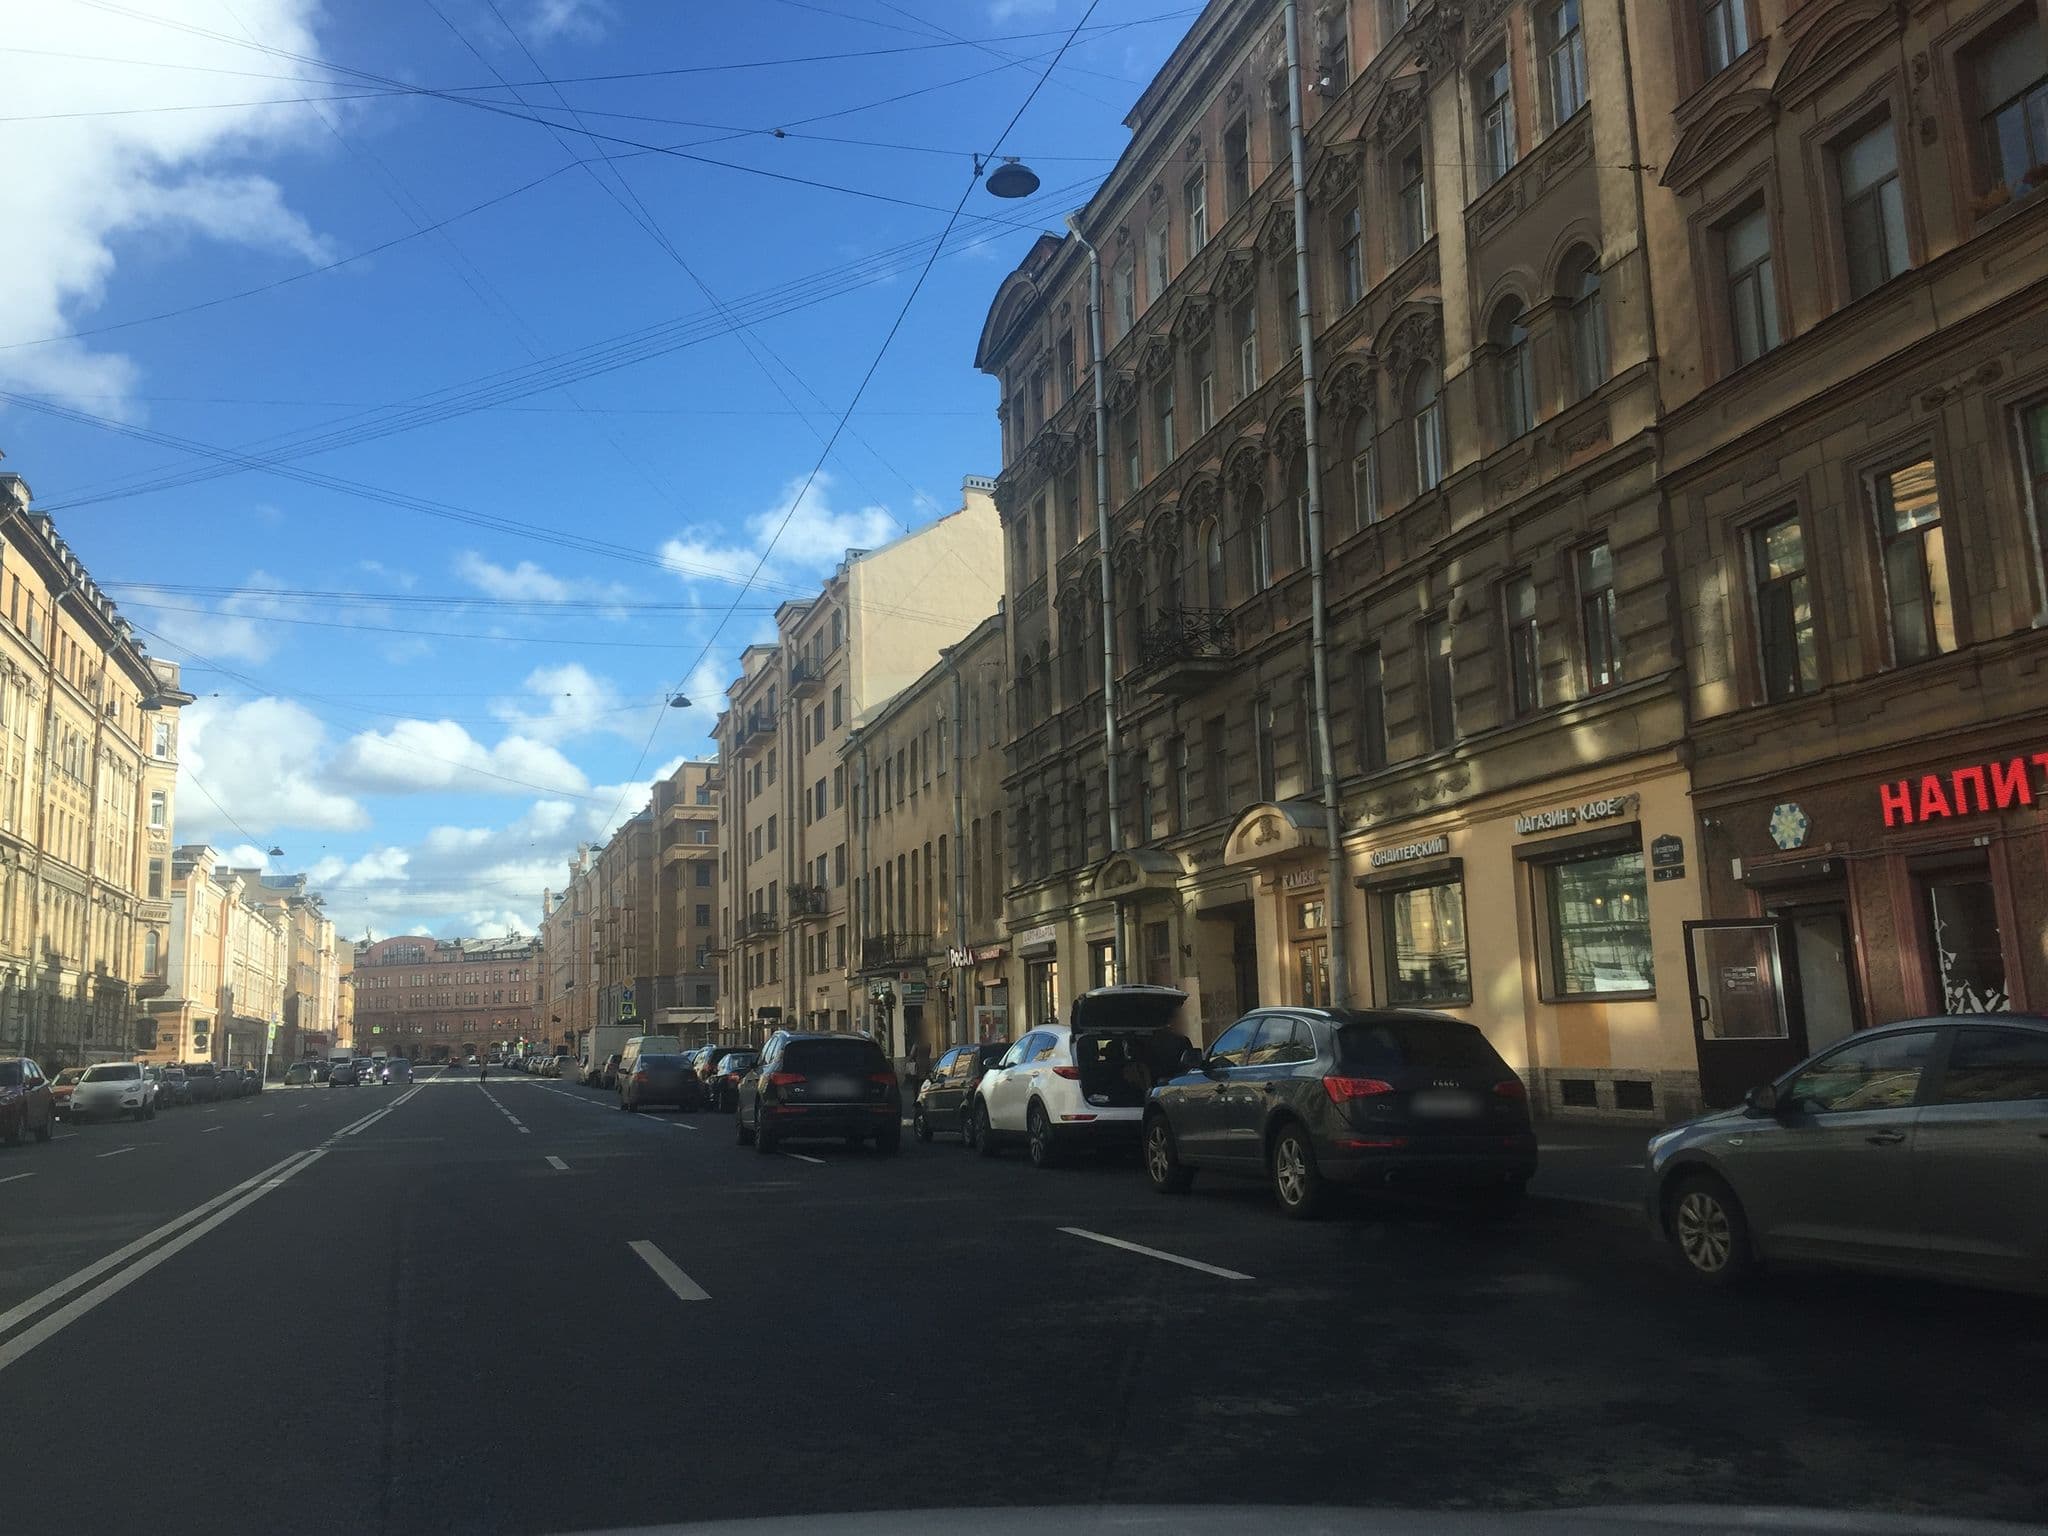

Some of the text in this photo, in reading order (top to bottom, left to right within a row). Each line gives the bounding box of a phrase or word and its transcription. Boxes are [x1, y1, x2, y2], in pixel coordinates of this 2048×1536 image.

[1515, 798, 1616, 834] МАГАЗИН КАФЕ
[1370, 837, 1443, 866] КОНДИТЕРСКИЙ
